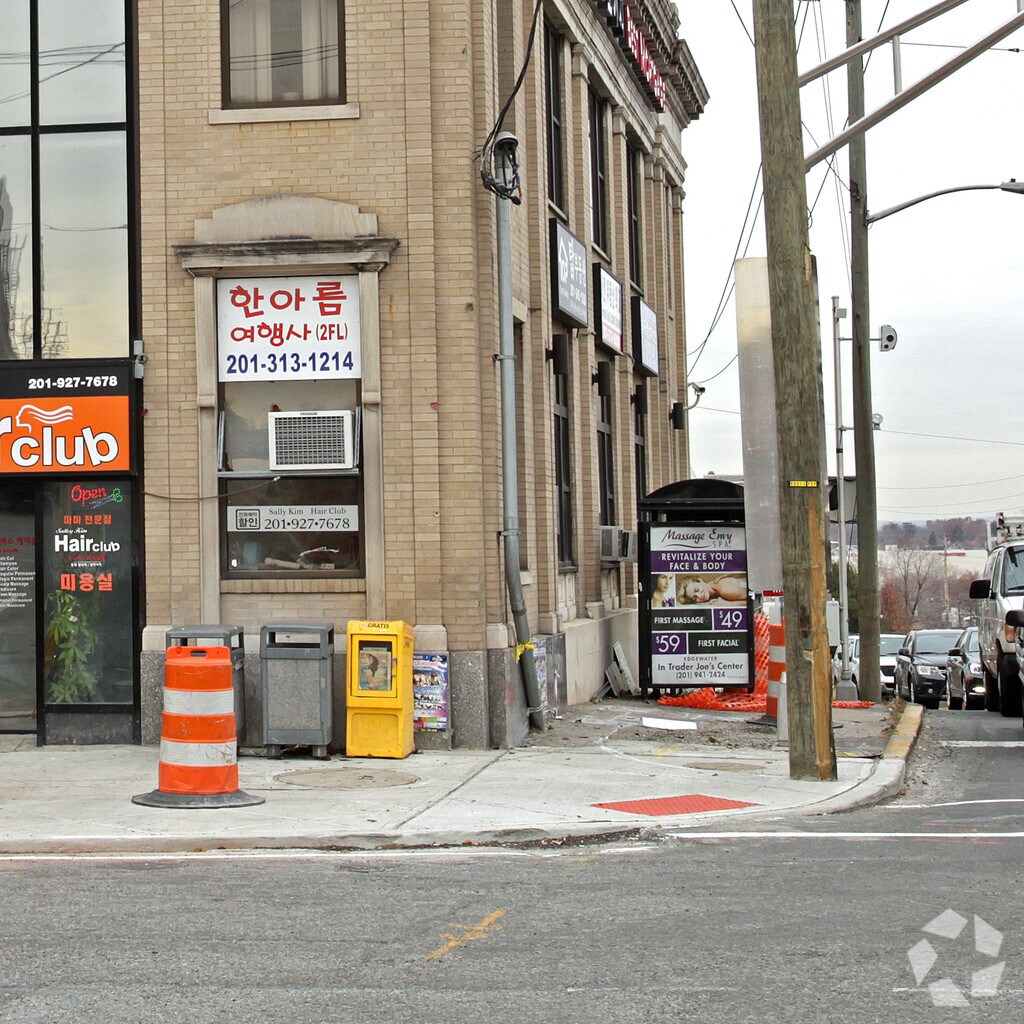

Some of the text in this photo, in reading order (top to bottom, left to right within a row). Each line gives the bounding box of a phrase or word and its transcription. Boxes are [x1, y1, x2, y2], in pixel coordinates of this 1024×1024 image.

[230, 282, 347, 318] 한아름
[231, 322, 348, 346] 여행사 (2FL)
[227, 351, 353, 373] 201-313-1214
[28, 376, 118, 389] 201-927-7678
[71, 485, 108, 507] Open
[268, 508, 286, 516] Sally
[310, 507, 327, 515] Hair
[239, 517, 258, 528] 할인
[661, 528, 732, 544] Massage Envy
[661, 552, 733, 561] REVITALIZE YOUR
[669, 562, 725, 570] FACE & BODY
[60, 573, 113, 592] 미용실
[719, 610, 743, 628] $49
[656, 634, 680, 653] $59
[698, 639, 739, 647] FIRST FACIAL
[657, 663, 666, 671] In
[668, 662, 694, 671] Trader
[717, 662, 743, 670] Center
